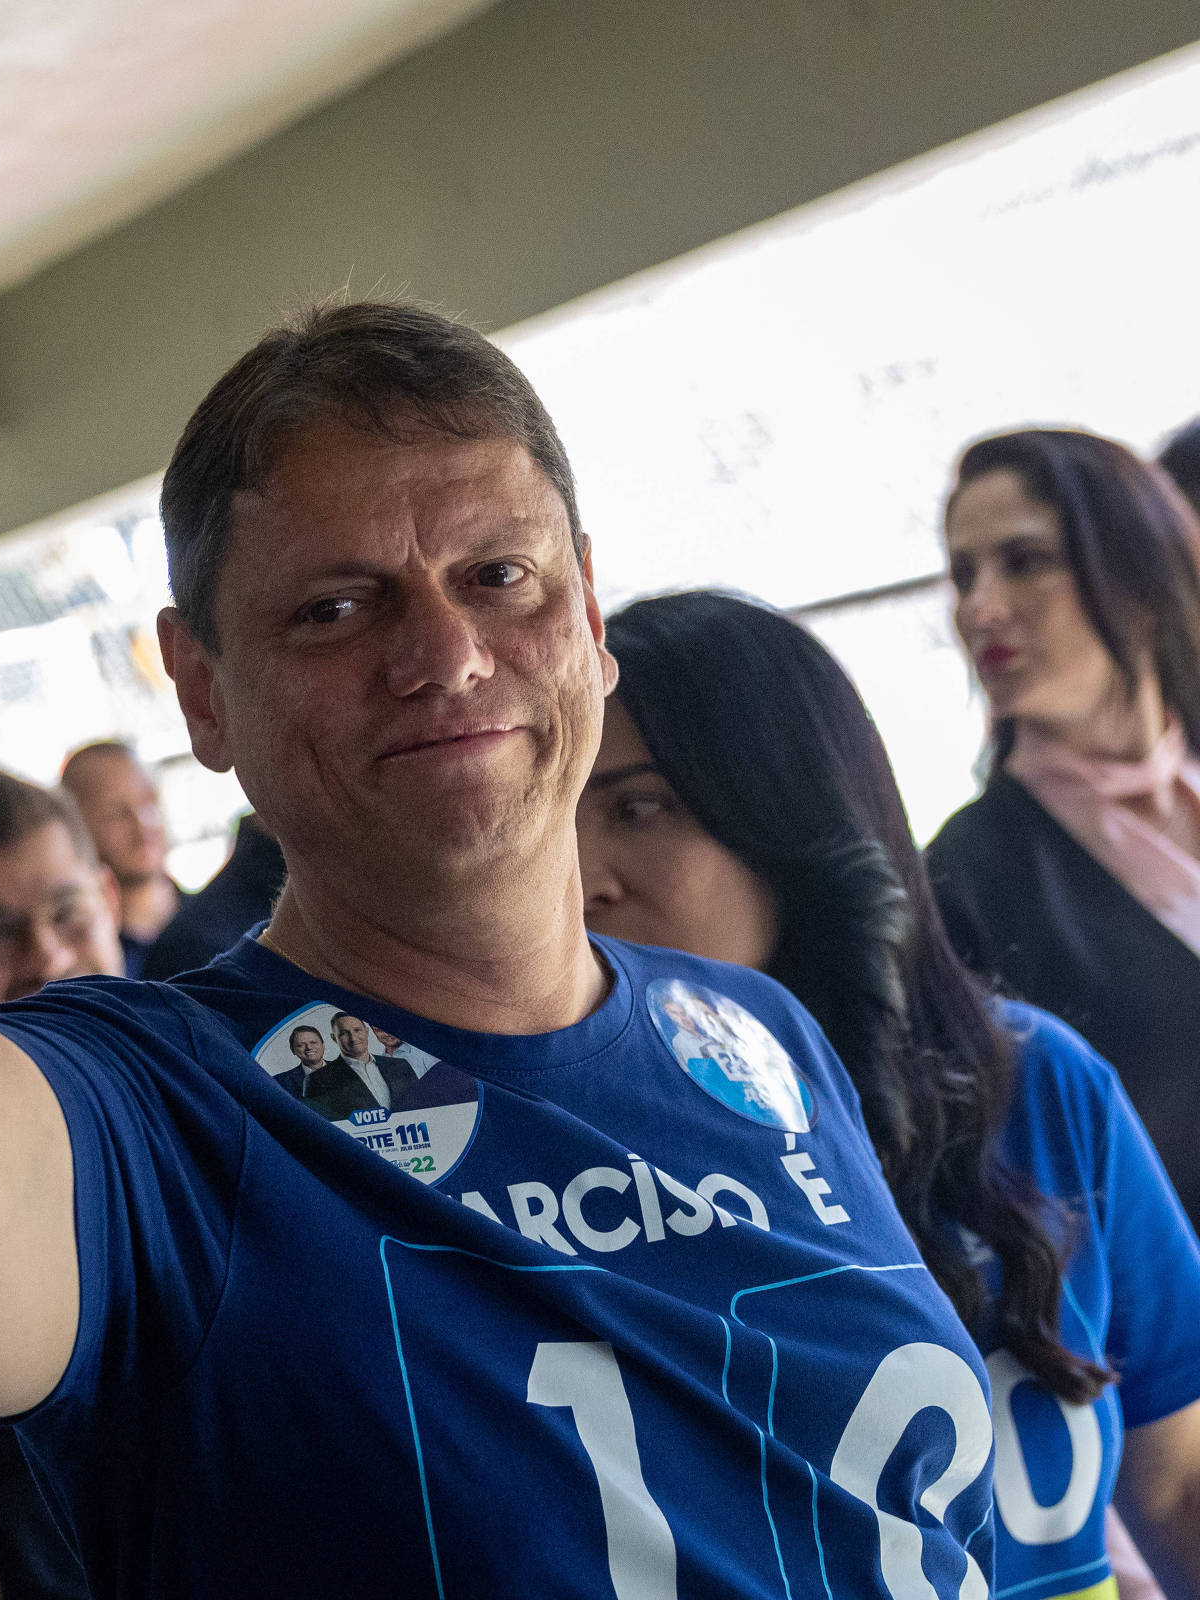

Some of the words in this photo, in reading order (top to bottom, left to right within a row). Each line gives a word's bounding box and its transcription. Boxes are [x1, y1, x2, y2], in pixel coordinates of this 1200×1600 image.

[353, 1108, 387, 1124] VOTE
[395, 1121, 430, 1146] 111
[410, 1155, 437, 1173] 22
[779, 1132, 851, 1226] É
